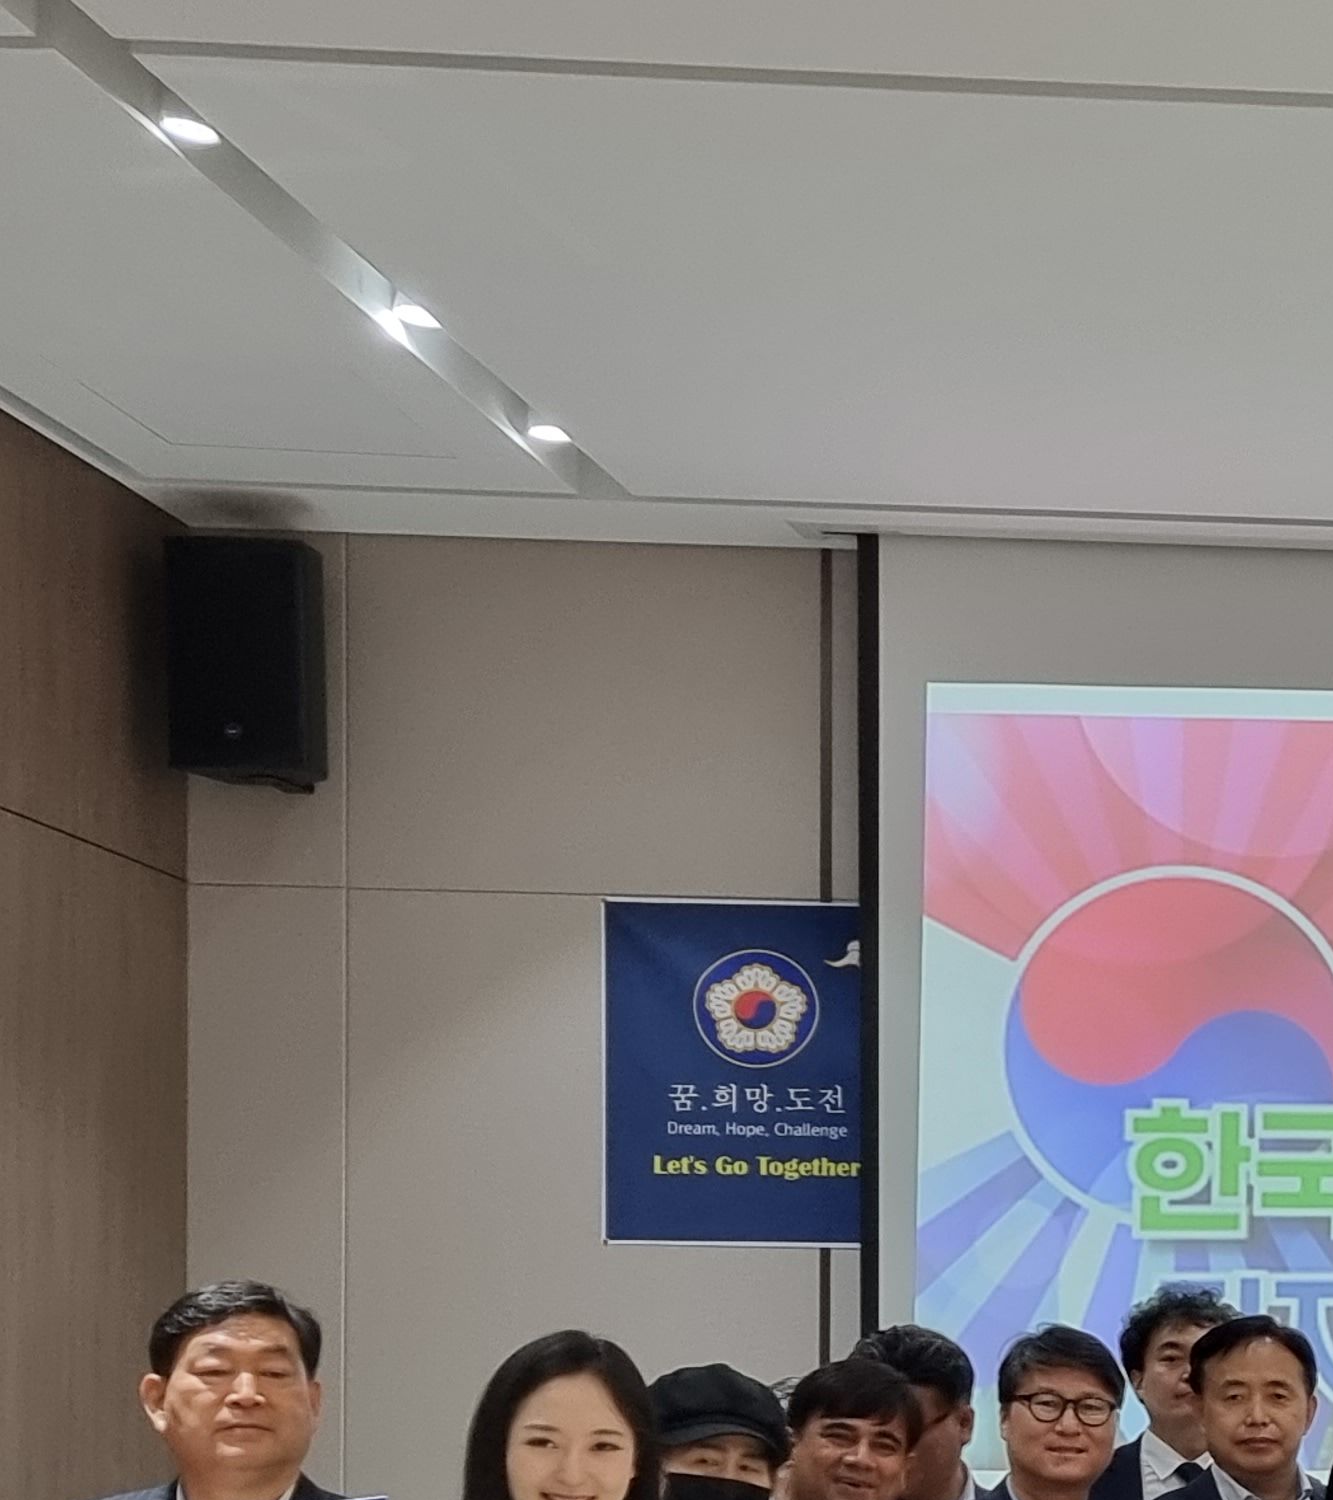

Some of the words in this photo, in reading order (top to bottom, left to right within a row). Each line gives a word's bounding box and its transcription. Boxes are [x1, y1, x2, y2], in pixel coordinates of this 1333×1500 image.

[667, 1121, 721, 1136] Dream,
[725, 1122, 770, 1137] Hope,
[774, 1122, 848, 1138] Challenge
[653, 1156, 708, 1177] Let's
[715, 1156, 749, 1176] Go
[757, 1156, 861, 1181] Together
